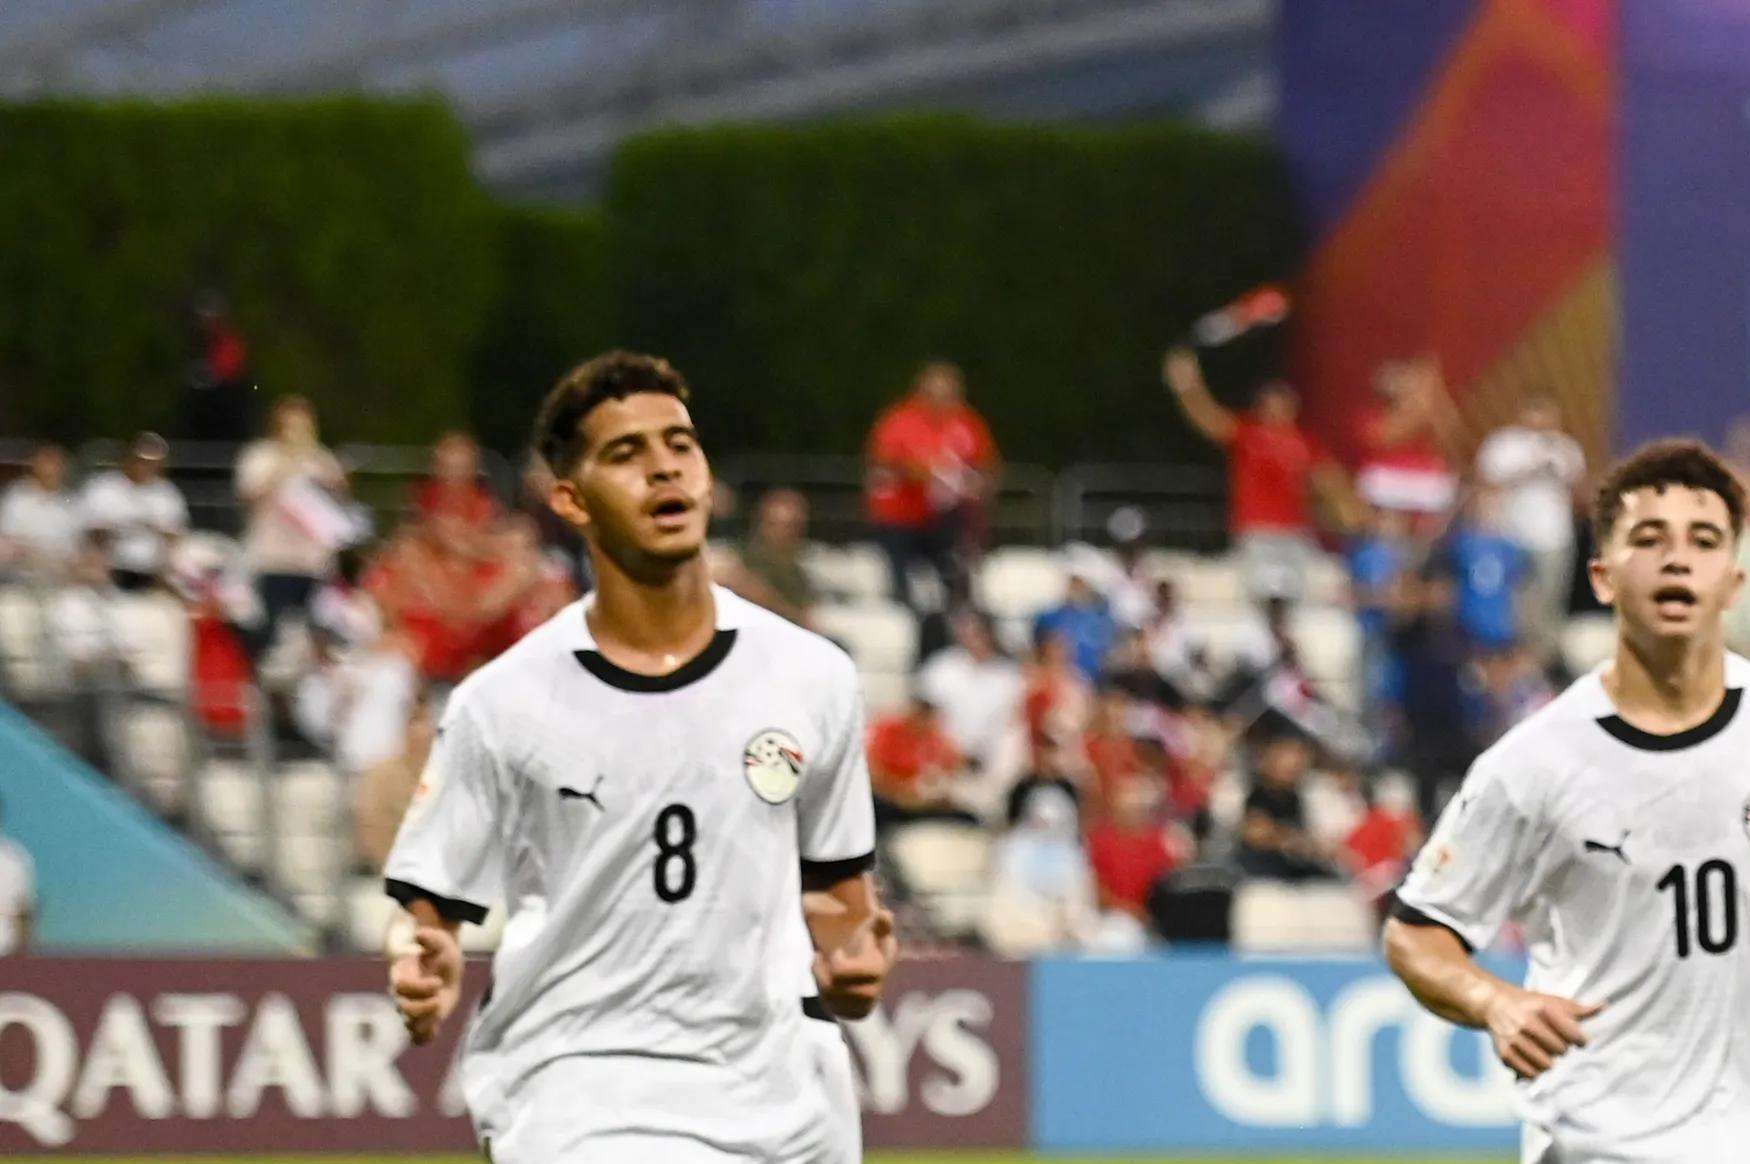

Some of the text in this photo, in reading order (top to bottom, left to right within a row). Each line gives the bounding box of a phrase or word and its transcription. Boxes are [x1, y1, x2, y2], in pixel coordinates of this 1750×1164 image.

[653, 803, 697, 904] 8
[1656, 859, 1737, 958] 10
[0, 989, 420, 1146] QATAR
